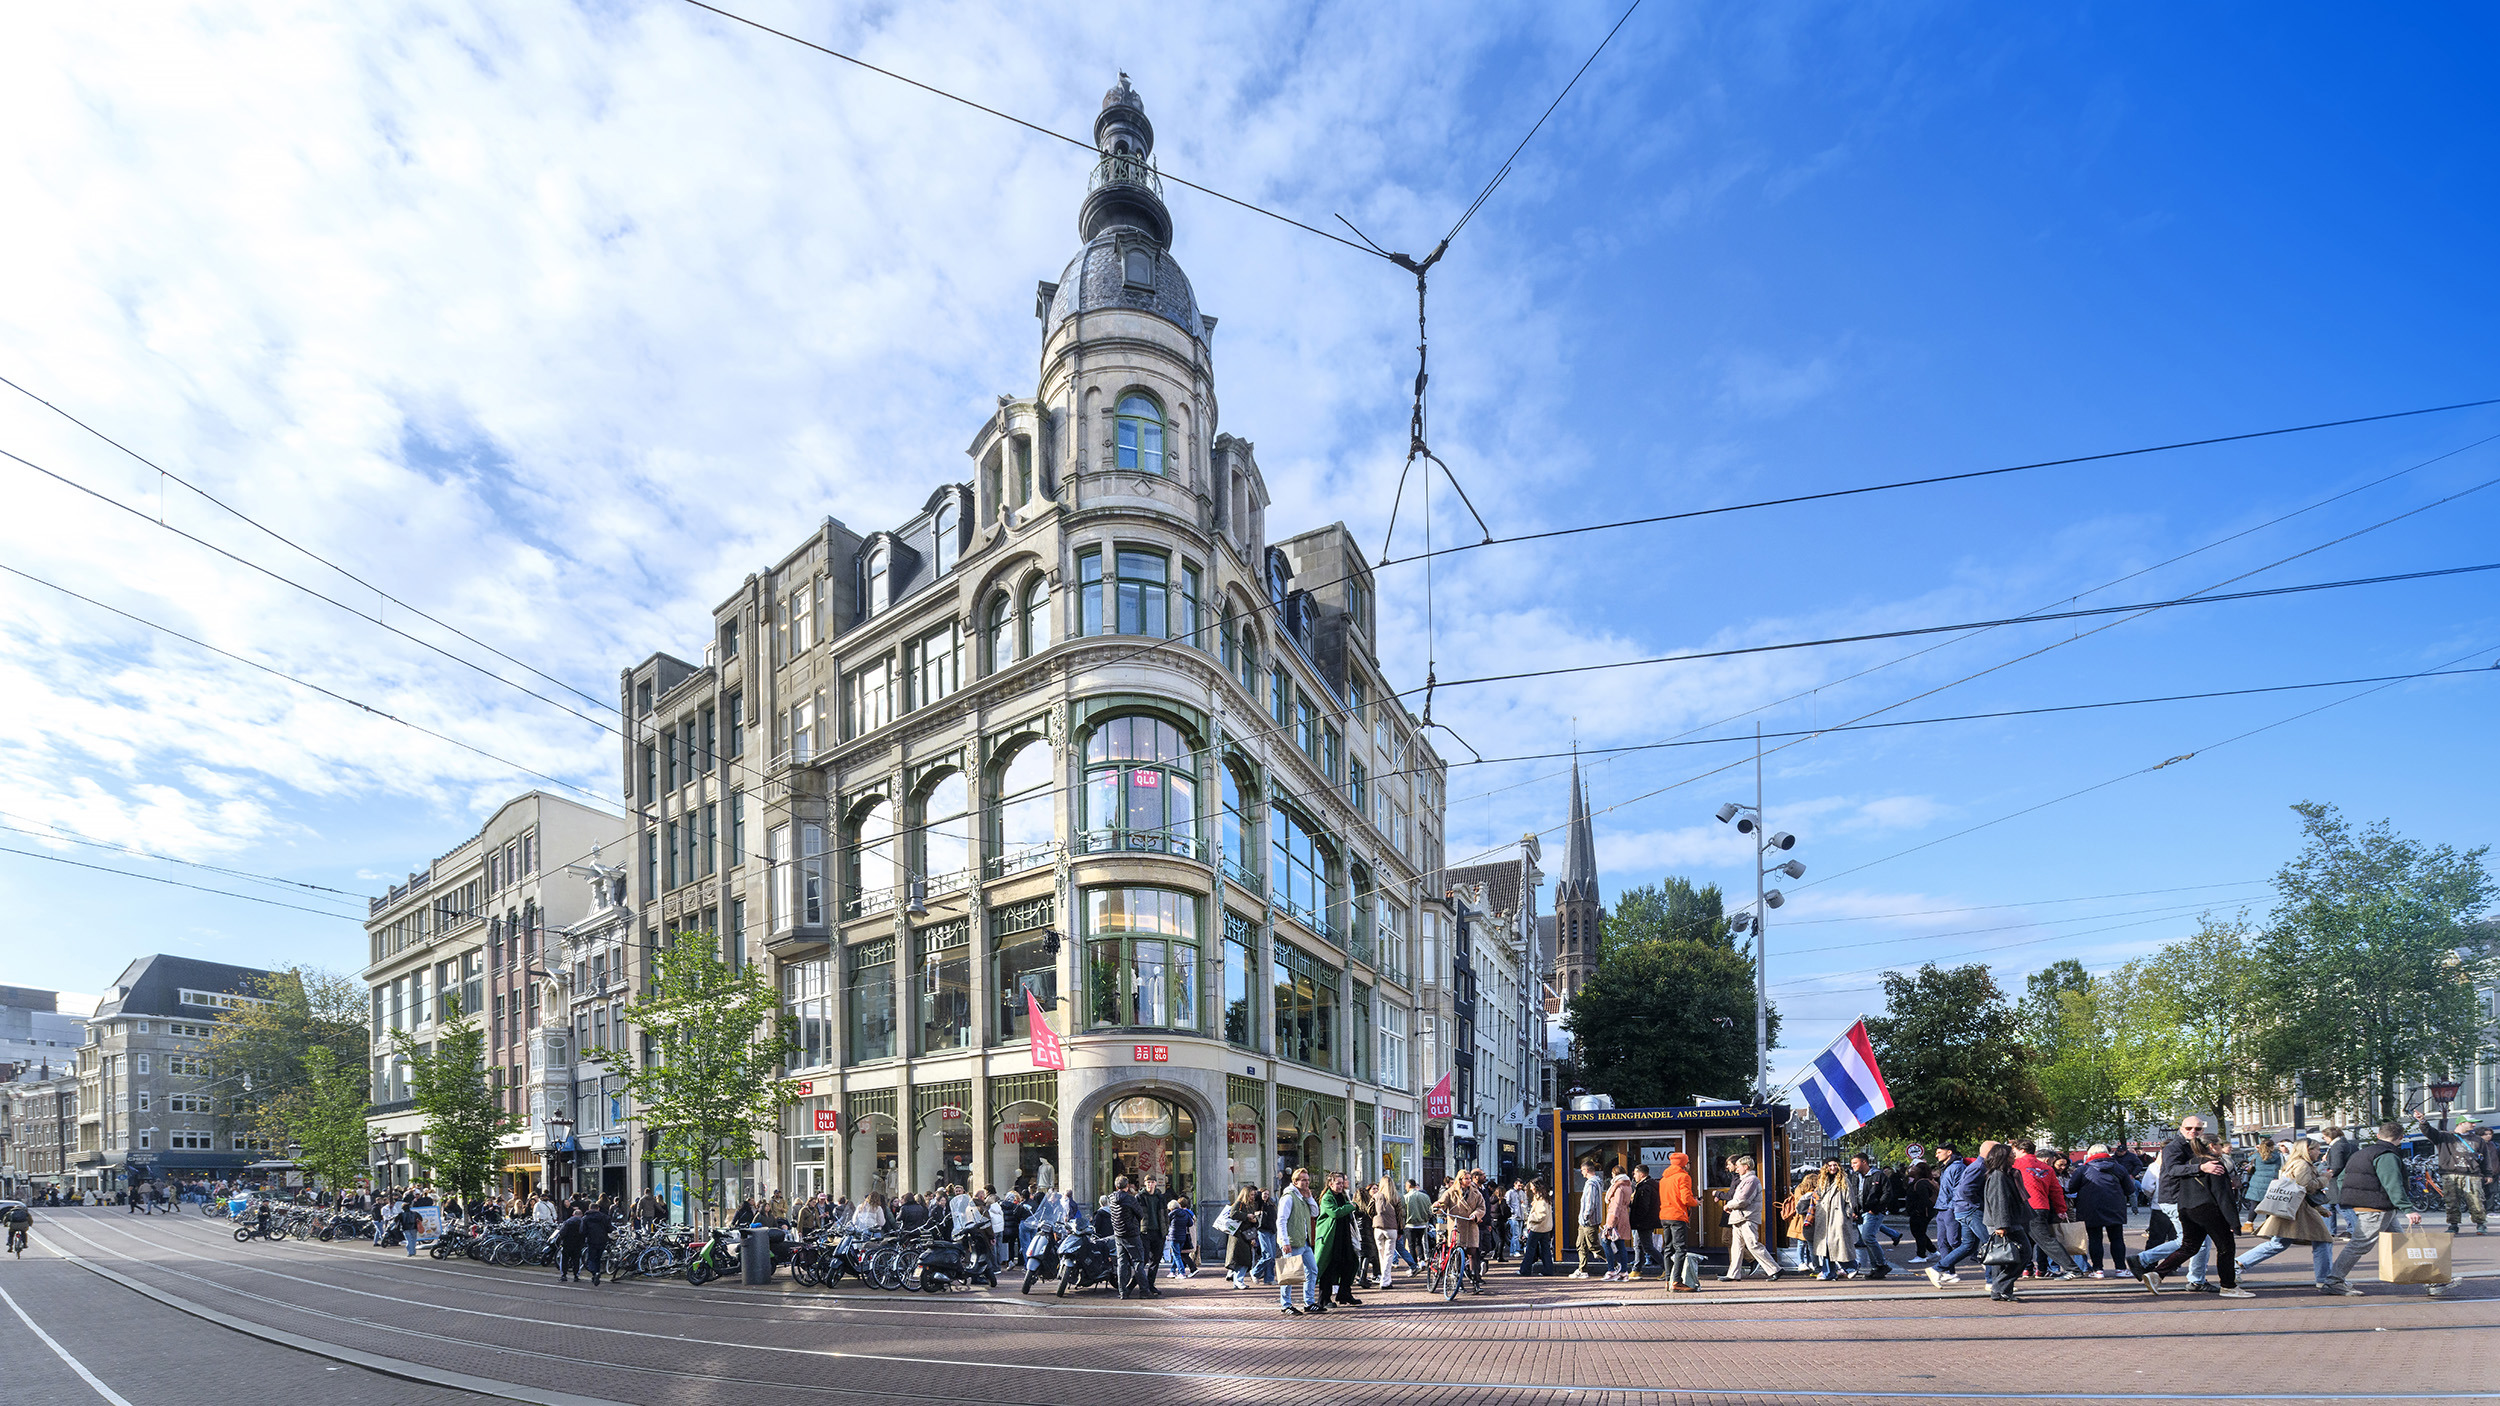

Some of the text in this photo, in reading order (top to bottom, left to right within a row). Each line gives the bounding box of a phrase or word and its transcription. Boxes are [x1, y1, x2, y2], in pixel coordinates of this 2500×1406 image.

[1137, 775, 1155, 785] QLO
[1430, 1095, 1448, 1105] UNI
[1430, 1105, 1450, 1116] QLO
[1566, 1109, 1740, 1121] FRENS HARINGHANDEL AMSTERDAM
[818, 1112, 833, 1120] UNI
[818, 1120, 835, 1129] QLO
[1003, 1131, 1024, 1144] NOW
[1241, 1132, 1257, 1144] OPEN
[2269, 1187, 2295, 1196] ultur
[2266, 1195, 2293, 1203] eutel
